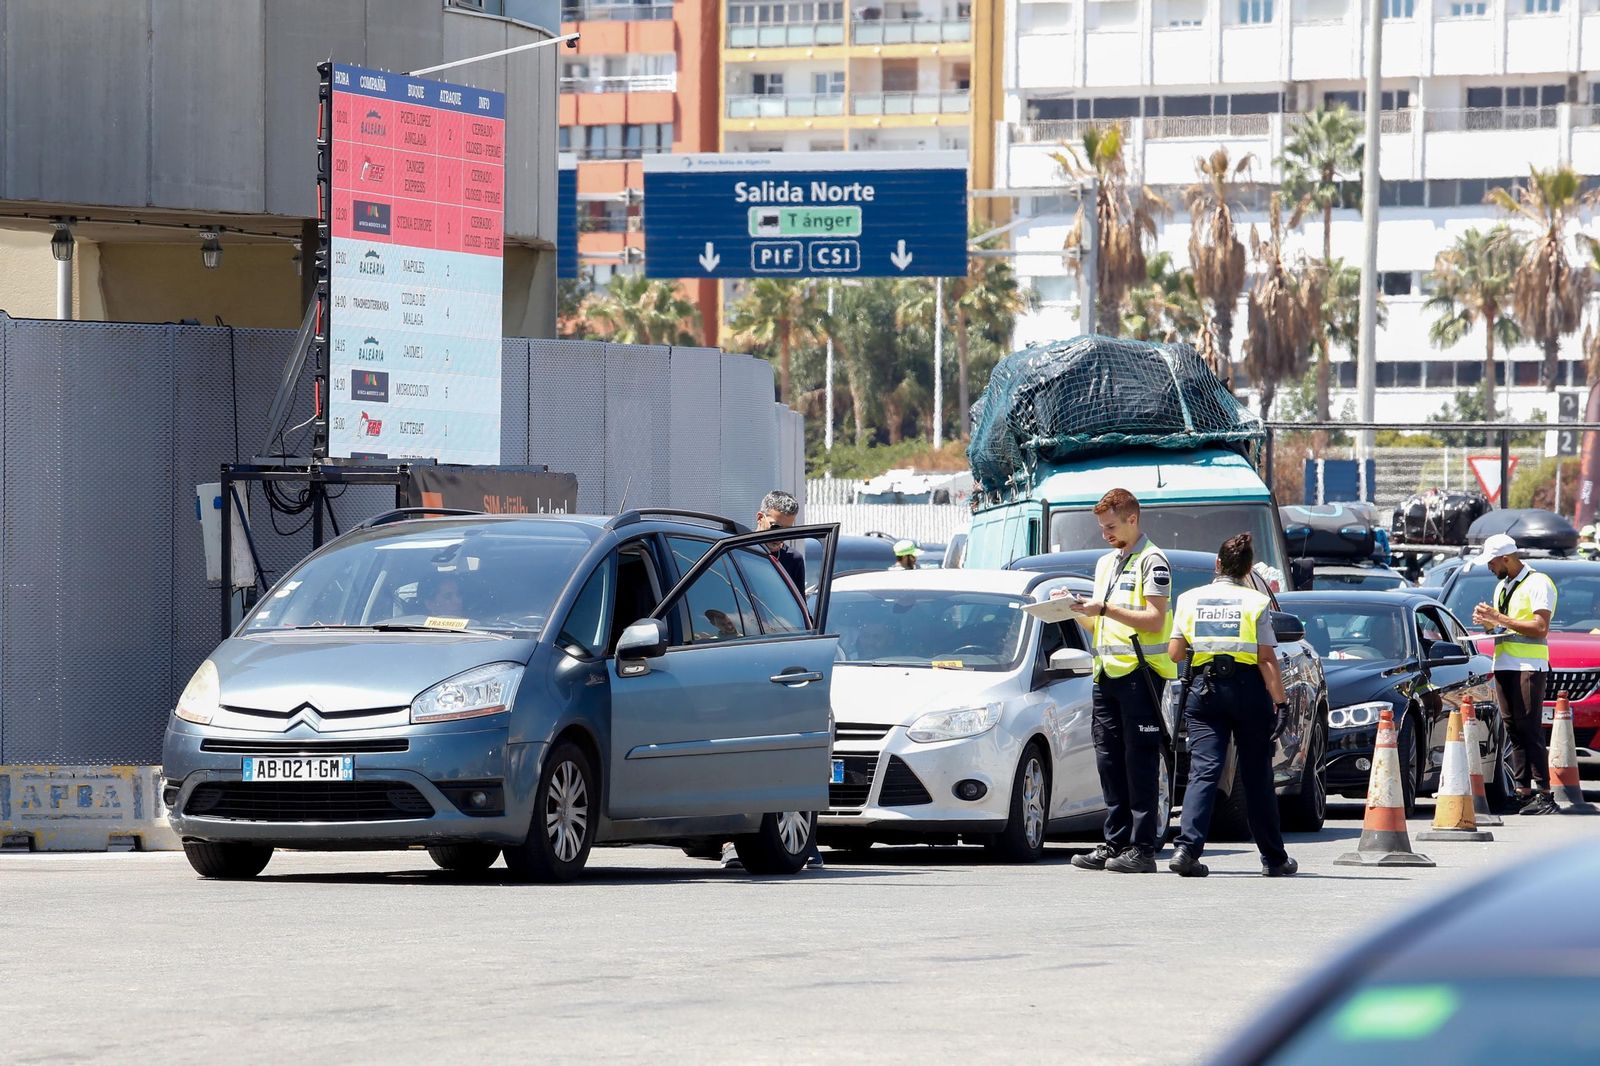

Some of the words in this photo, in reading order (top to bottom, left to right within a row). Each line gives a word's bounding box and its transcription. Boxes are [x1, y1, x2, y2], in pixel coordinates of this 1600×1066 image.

[335, 70, 349, 85] HORA
[408, 84, 424, 99] BUQUE
[440, 90, 461, 106] ATRAQUE
[478, 96, 490, 110] INFO
[735, 181, 804, 202] Salida
[810, 182, 875, 202] Norte
[761, 248, 794, 264] PIF
[817, 248, 850, 264] CSI
[1561, 431, 1572, 452] 2
[1196, 608, 1241, 619] Trablisa
